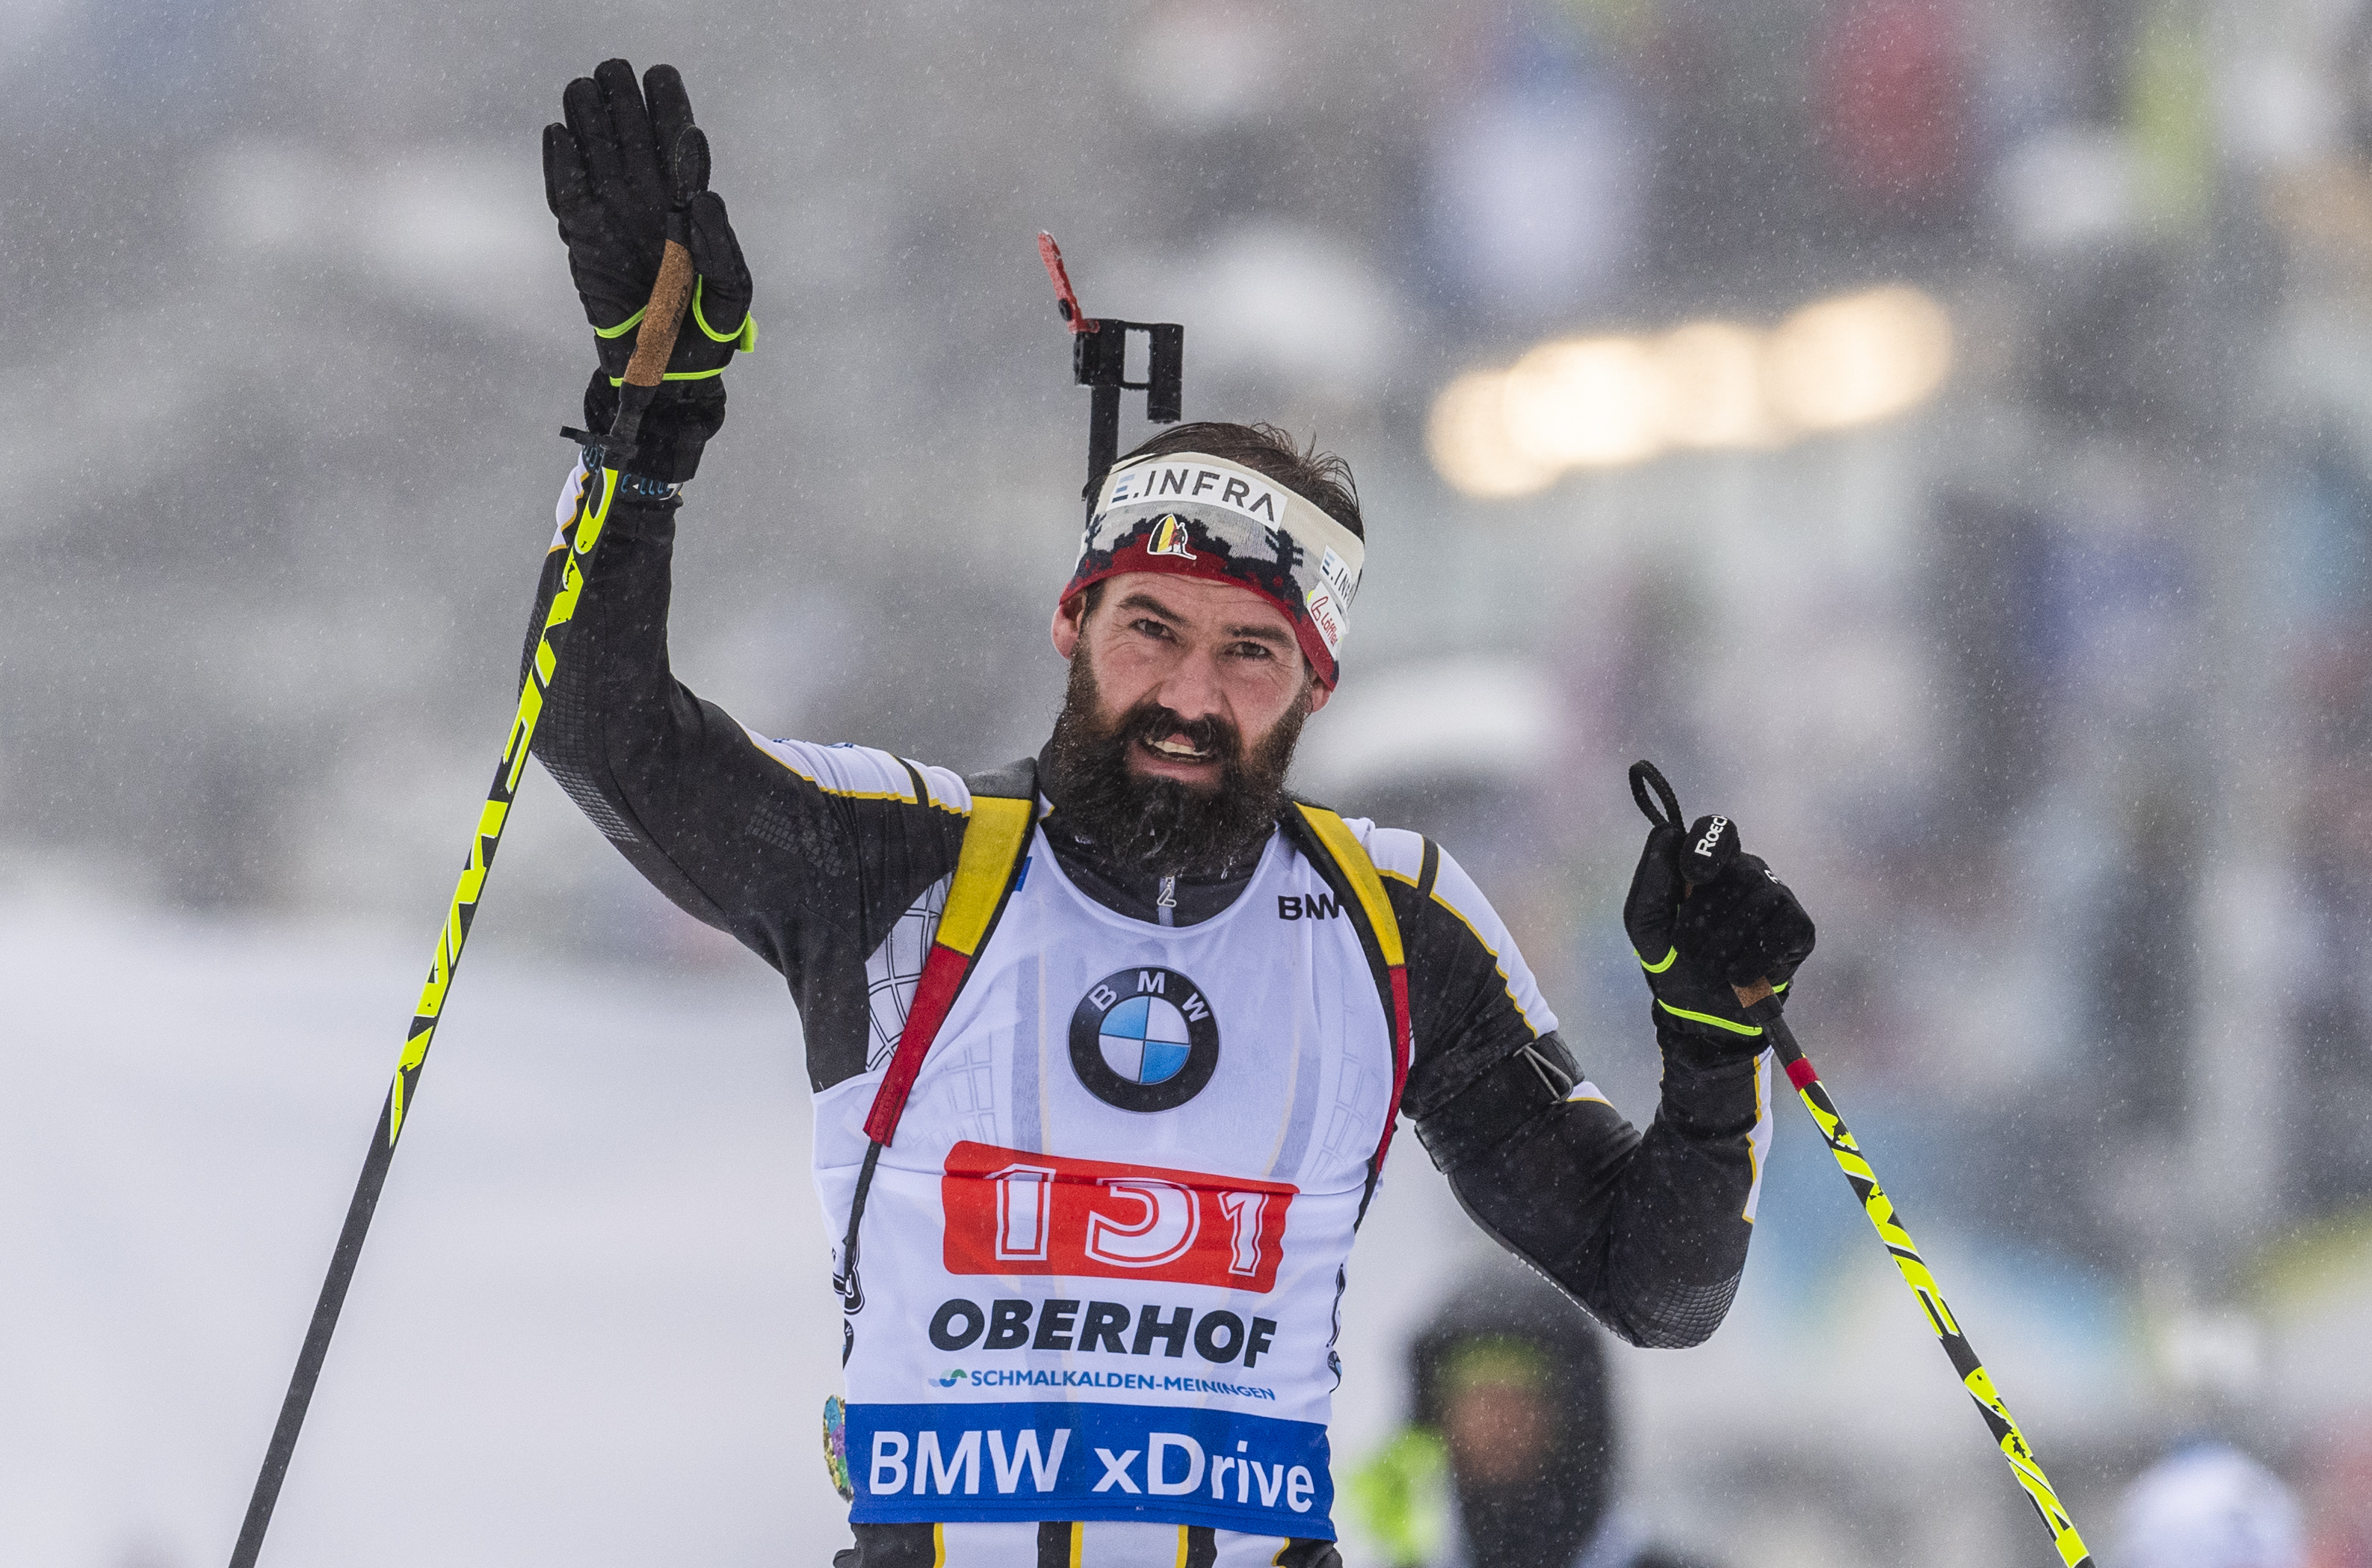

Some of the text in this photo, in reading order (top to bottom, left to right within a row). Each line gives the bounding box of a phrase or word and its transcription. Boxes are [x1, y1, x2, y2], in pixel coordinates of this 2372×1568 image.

[1112, 469, 1275, 523] E.INFRA
[1087, 970, 1210, 1023] BMW
[928, 1298, 1278, 1369] OBERHOF
[971, 1369, 1276, 1401] SCHMALKALDEN-MEININGEN
[868, 1427, 1316, 1513] BMW xDrive
